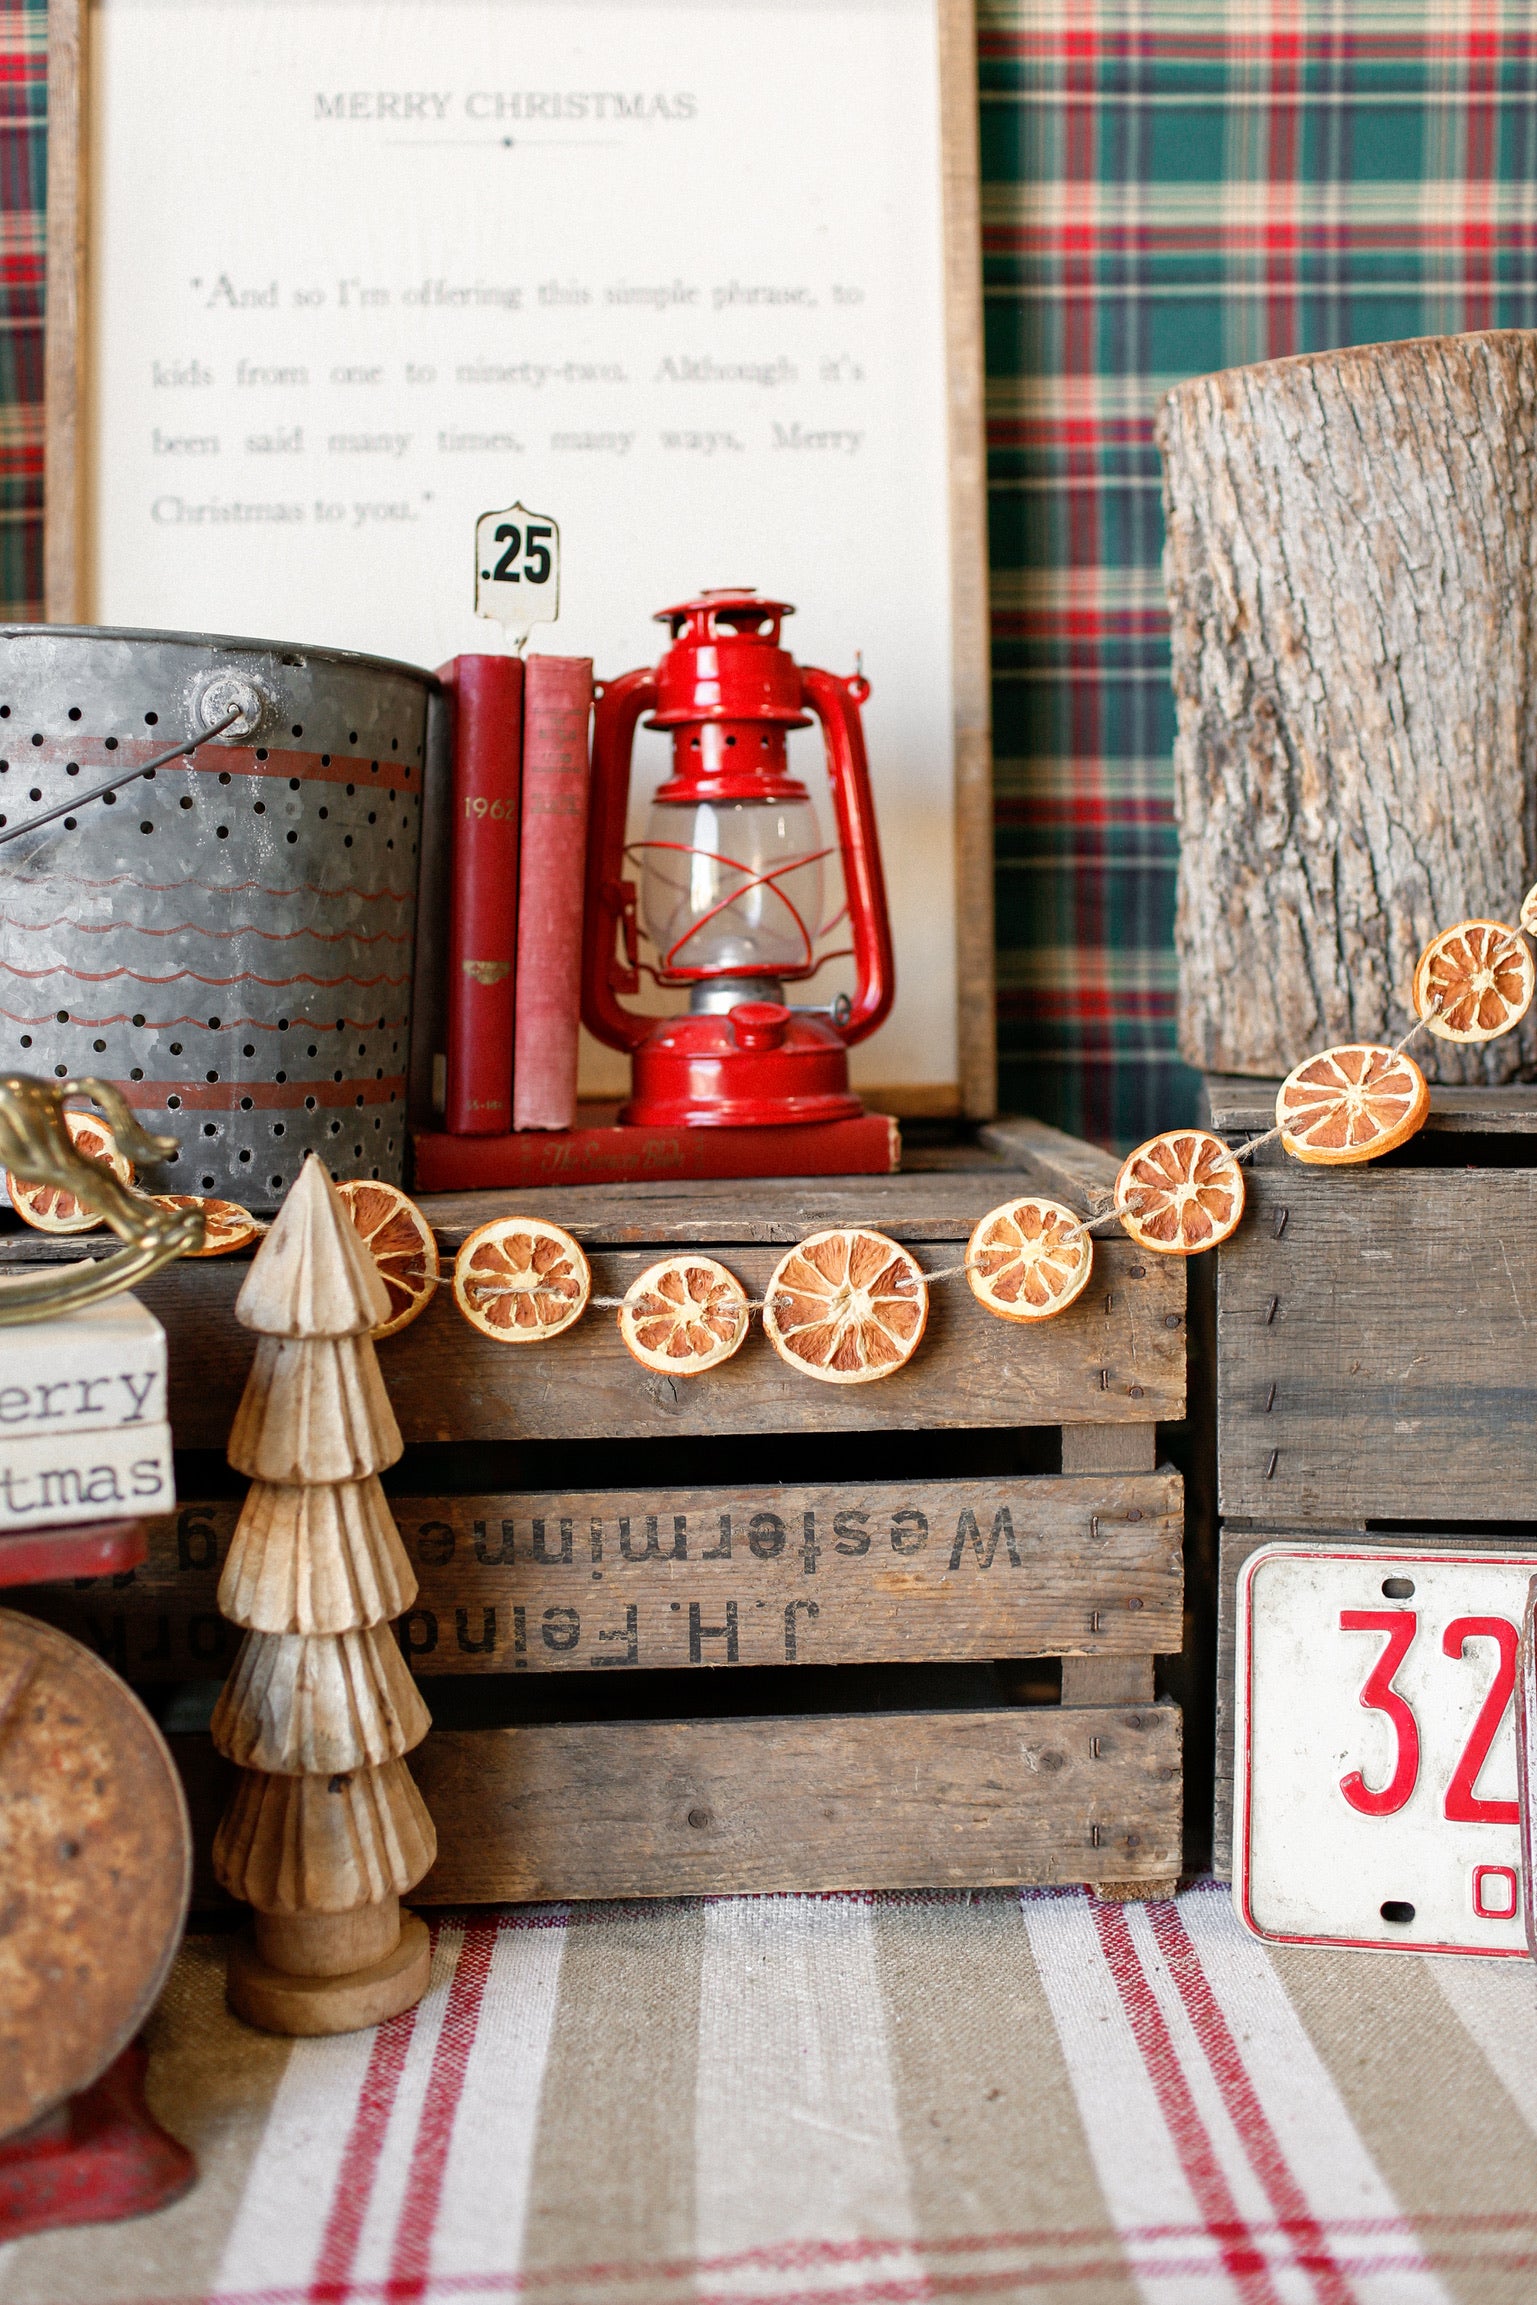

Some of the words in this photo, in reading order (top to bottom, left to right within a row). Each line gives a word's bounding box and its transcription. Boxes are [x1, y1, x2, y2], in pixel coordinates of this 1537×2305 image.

[315, 90, 451, 120] MERRY
[464, 90, 698, 120] CHRISTMAS
[293, 287, 325, 308] so
[338, 279, 389, 308] I'm
[402, 278, 523, 313] offering
[537, 279, 591, 306] this
[604, 279, 698, 313] simple
[711, 280, 817, 311] phrase,
[831, 283, 865, 306] to
[152, 359, 213, 388] kids
[236, 358, 308, 387] from
[329, 364, 384, 386] one
[404, 361, 437, 386] to
[655, 355, 798, 390] Although
[819, 354, 864, 384] it's
[152, 428, 220, 455] been
[246, 426, 303, 454] said
[327, 433, 411, 458] many
[437, 430, 524, 455] times,
[550, 432, 636, 457] many
[660, 430, 744, 457] ways,
[771, 422, 864, 456] Merry
[151, 496, 305, 526] Christmas
[314, 500, 345, 523] to
[481, 523, 553, 584] .25
[464, 796, 516, 821] 1962
[398, 1603, 638, 1671] Feind
[1340, 1610, 1519, 1825] 32
